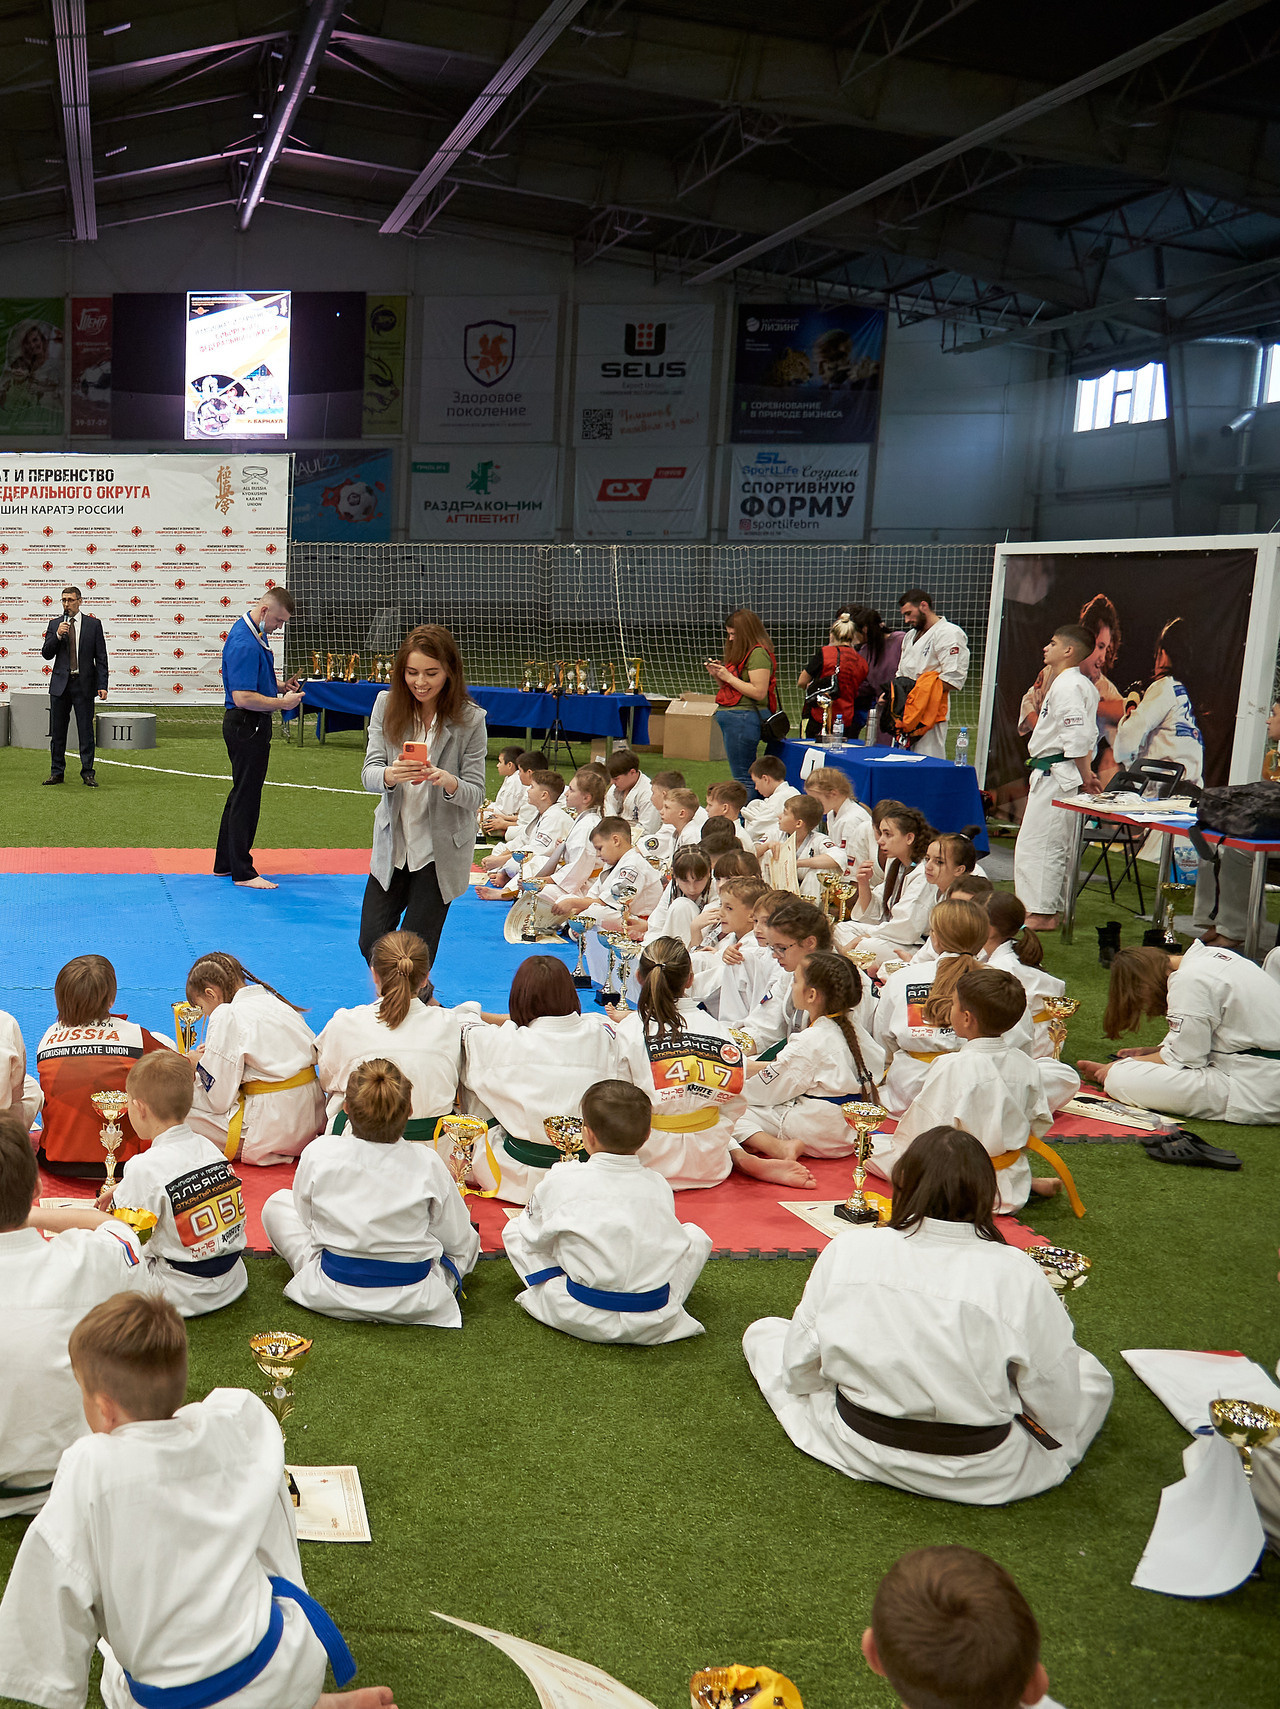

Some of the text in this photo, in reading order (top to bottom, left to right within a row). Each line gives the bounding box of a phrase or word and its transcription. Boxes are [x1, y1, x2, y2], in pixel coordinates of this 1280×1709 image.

[601, 362, 686, 378] SEUS
[453, 391, 522, 405] Здоровое
[446, 406, 527, 417] поколение
[14, 469, 24, 482] И
[28, 469, 114, 482] ПЕРВЕНСТВО
[742, 465, 799, 476] SportLife
[802, 465, 859, 481] Создаем
[96, 485, 151, 499] ОКРУГА
[742, 482, 855, 493] СПОРТИВНУЮ
[31, 505, 74, 515] КАРАТЭ
[78, 505, 124, 515] РОССИИ
[424, 501, 542, 512] РАЗДРАКОНИМ
[740, 496, 854, 517] ФОРМУ
[446, 514, 519, 523] АППЕТИТ!
[752, 519, 820, 530] sportlifebrn
[111, 725, 133, 741] III
[46, 1028, 121, 1046] RUSSIA
[39, 1046, 129, 1060] KYOKUSHIN KARATE UNION
[649, 1040, 719, 1054] АЛЬЯНСА
[664, 1060, 732, 1088] 417
